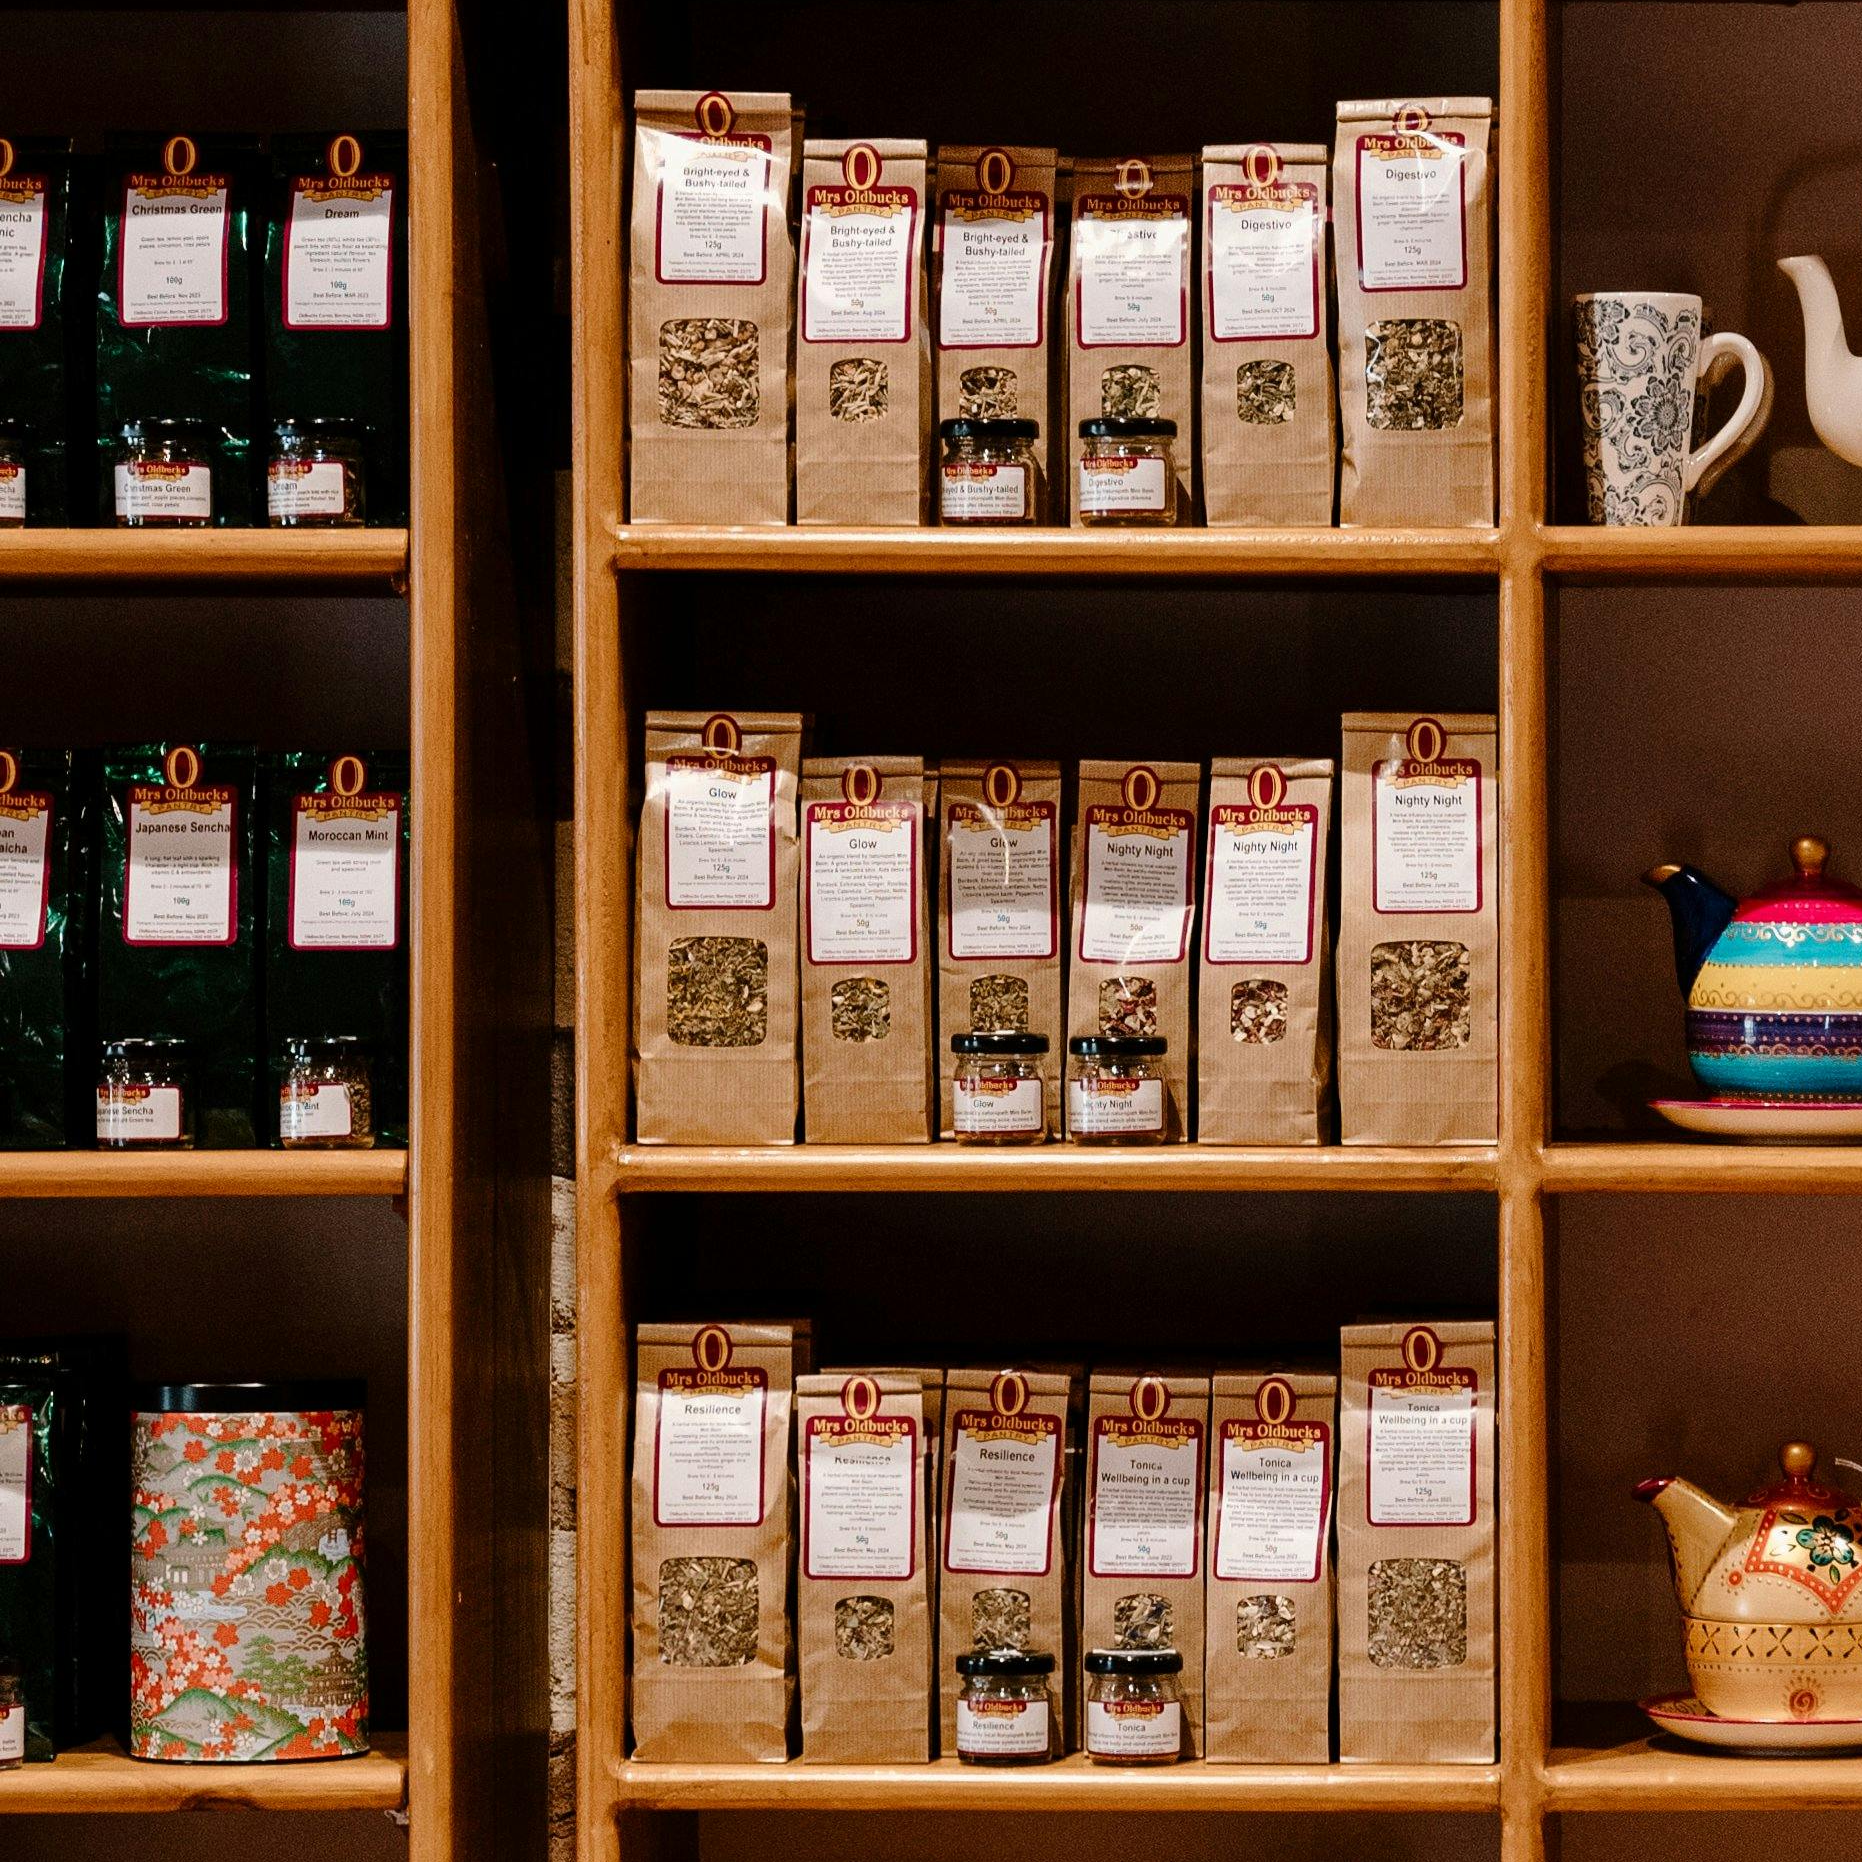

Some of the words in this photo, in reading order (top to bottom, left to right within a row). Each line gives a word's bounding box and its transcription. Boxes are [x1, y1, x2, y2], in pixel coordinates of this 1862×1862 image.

[1386, 169, 1436, 181] Digestivo
[132, 176, 157, 187] Mrs
[162, 176, 224, 187] Oldbucks
[300, 178, 323, 188] Mrs
[329, 176, 389, 188] Oldbucks
[815, 190, 840, 202] Mrs
[845, 190, 908, 203] Oldbucks
[950, 194, 974, 206] Mrs
[979, 195, 1040, 208] Oldbucks
[132, 205, 186, 215] Christmas
[190, 204, 221, 213] Green
[1088, 199, 1112, 210] Mrs
[1118, 199, 1179, 210] Oldbucks
[325, 209, 359, 218] Dream
[838, 206, 884, 215] PANTRY
[831, 226, 885, 236] Bright-eyed
[1242, 220, 1291, 231] Digestivo
[833, 238, 891, 248] Bushy-tailed
[964, 232, 1018, 244] Bright-eyed
[1022, 234, 1028, 243] &
[706, 241, 721, 249] 125g
[1405, 246, 1421, 255] 125g
[966, 246, 1024, 257] Bushy-tailed
[135, 789, 160, 800] Mrs
[166, 789, 228, 800] Oldbucks
[709, 788, 736, 799] Glow
[301, 797, 326, 808] Mrs
[332, 796, 394, 808] Oldbucks
[1396, 796, 1429, 808] Nighty
[1434, 796, 1461, 807] Night
[813, 807, 841, 820] Mrs
[845, 806, 910, 819] Oldbucks
[1219, 809, 1244, 821] Mrs
[1250, 808, 1310, 822] Oldbucks
[136, 823, 186, 835] Japanese
[191, 820, 232, 835] Sencha
[838, 822, 885, 831] PANTRY
[309, 831, 361, 840] Moroccan
[366, 830, 388, 840] Mint
[850, 839, 877, 849] Glow
[1234, 842, 1266, 854] Nighty
[1271, 842, 1297, 853] Night
[1108, 843, 1141, 857] Nighty
[1145, 845, 1173, 859] Night
[713, 864, 730, 872] 125g
[1421, 872, 1437, 880] 125g
[667, 1373, 692, 1386] Mrs
[697, 1372, 759, 1385] Oldbucks
[685, 1405, 741, 1414] Resilience
[813, 1419, 840, 1433] Mrs
[845, 1418, 908, 1432] Oldbucks
[1228, 1425, 1253, 1437] Mrs
[1258, 1425, 1320, 1439] Oldbucks
[980, 1449, 1034, 1461] Resilience
[1131, 1460, 1162, 1470] Tonica
[1260, 1458, 1291, 1467] Tonica
[1102, 1473, 1148, 1485] Wellbeing
[1172, 1478, 1190, 1486] cup
[1231, 1471, 1277, 1482] Wellbeing
[1301, 1475, 1320, 1485] cup
[703, 1483, 719, 1492] 125g
[1416, 1488, 1432, 1497] 125g
